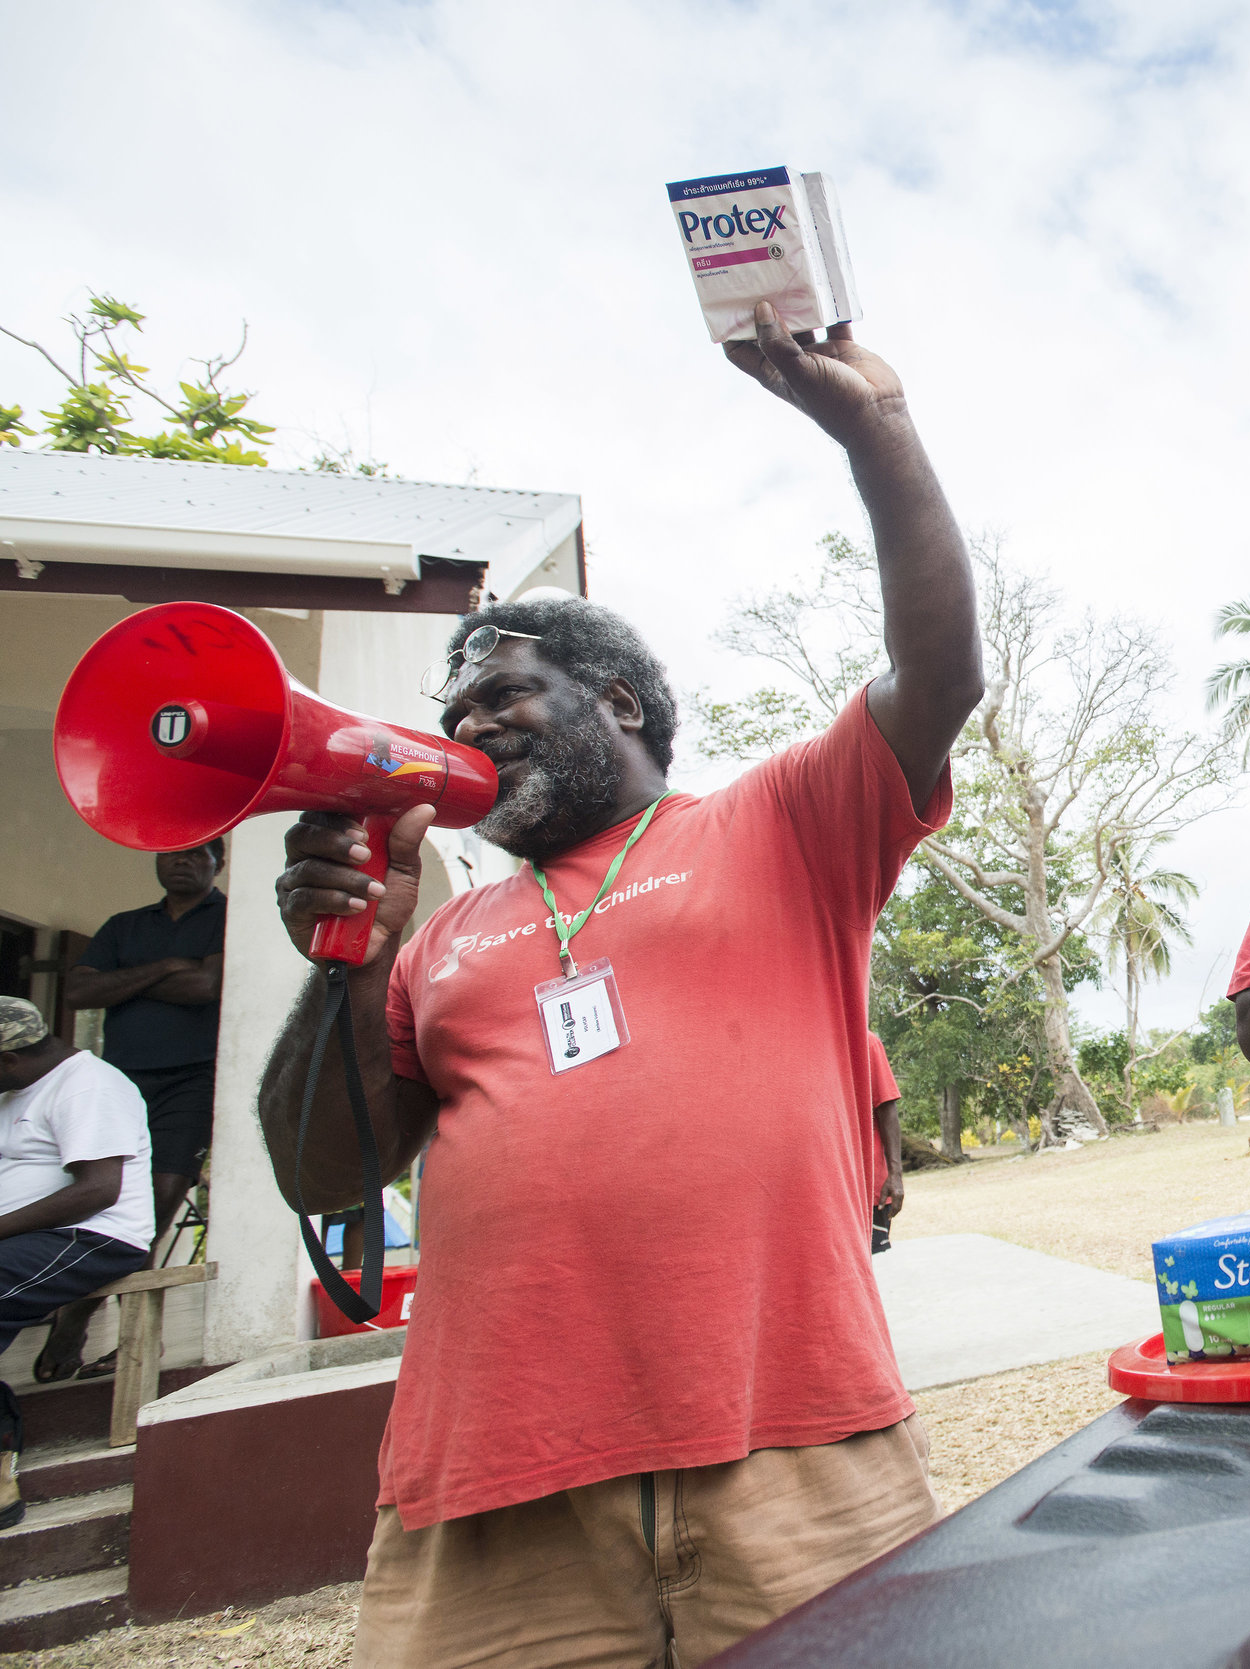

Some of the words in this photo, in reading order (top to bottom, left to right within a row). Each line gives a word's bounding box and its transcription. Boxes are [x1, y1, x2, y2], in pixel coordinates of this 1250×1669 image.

[678, 204, 787, 242] Protex
[390, 743, 440, 763] MEGAPHONE
[477, 922, 537, 953] Save
[1202, 1302, 1236, 1312] REGULAR
[1209, 1335, 1219, 1344] 10
